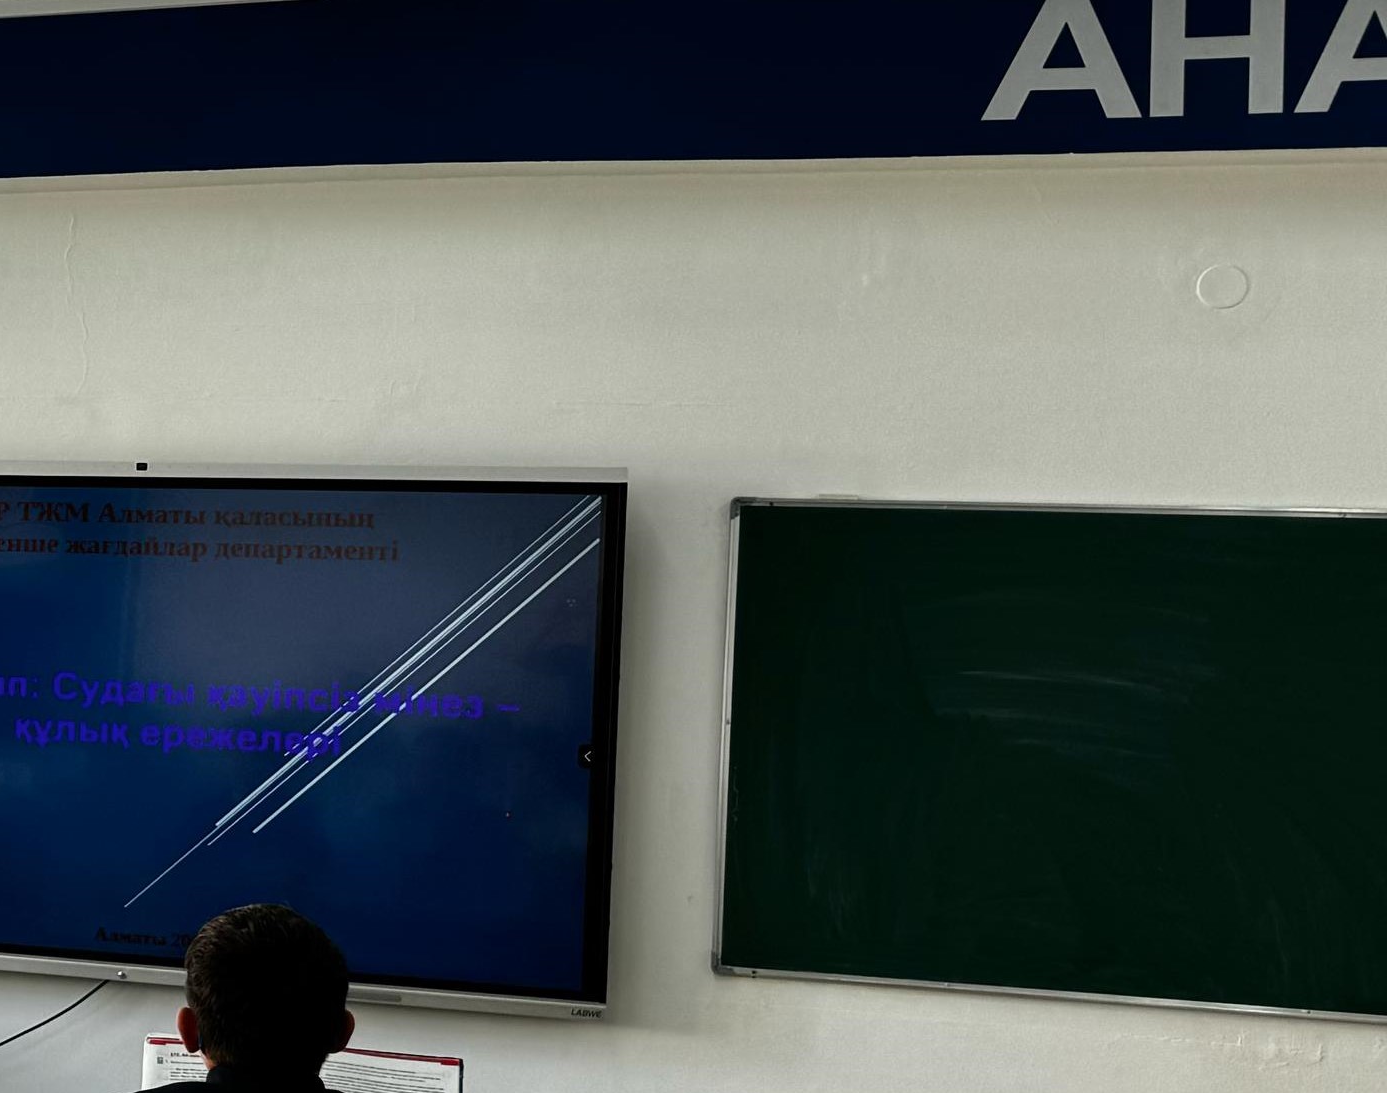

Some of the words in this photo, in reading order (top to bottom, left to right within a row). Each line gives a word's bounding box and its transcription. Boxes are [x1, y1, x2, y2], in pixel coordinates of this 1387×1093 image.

[18, 501, 89, 523] ТЖМ
[99, 502, 205, 525] Алматы
[214, 508, 374, 530] қаласының
[66, 536, 206, 561] жағдайлар
[214, 538, 400, 564] департаменті
[53, 671, 195, 709] Судағы
[207, 679, 359, 716] қауіпсіз
[372, 690, 484, 721] мінез
[15, 715, 130, 750] құлық
[139, 722, 341, 763] ережелері
